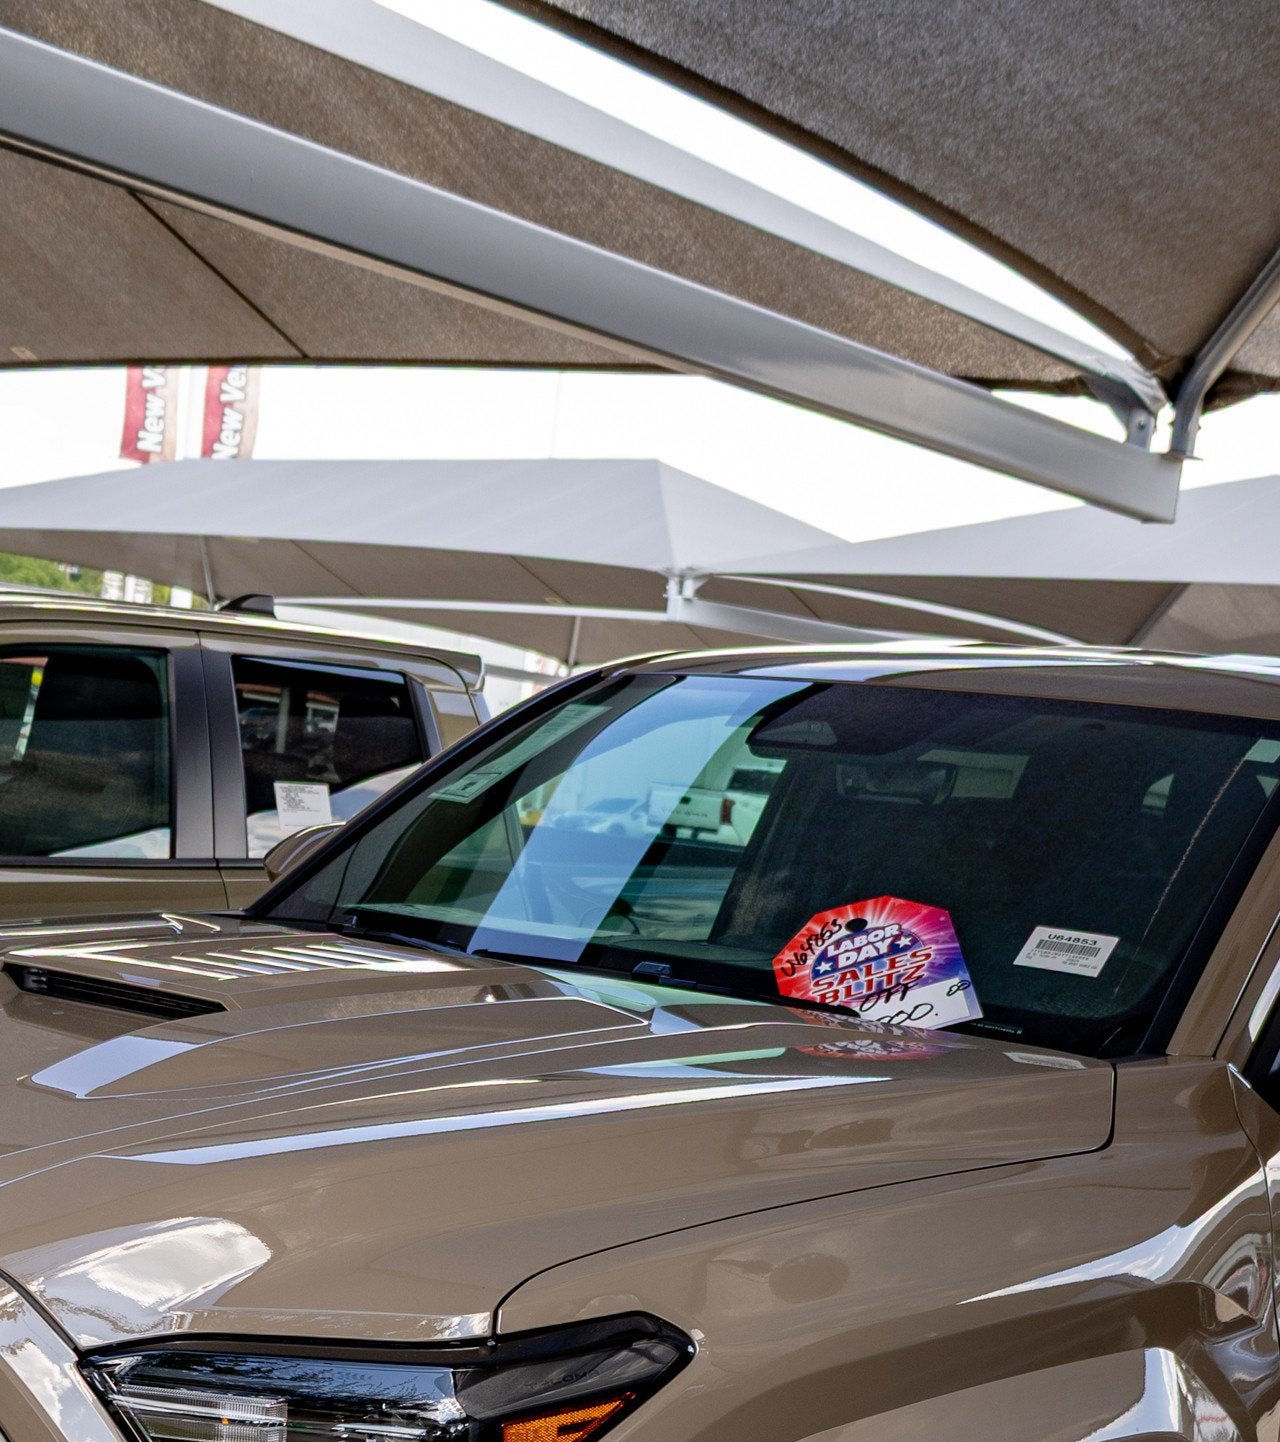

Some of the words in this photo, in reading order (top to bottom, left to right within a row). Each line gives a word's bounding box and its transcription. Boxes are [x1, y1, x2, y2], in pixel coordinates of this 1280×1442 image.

[220, 367, 247, 402] Ve
[136, 393, 165, 453] New
[826, 923, 901, 957] LABOR
[837, 938, 891, 968] DAY
[1048, 933, 1097, 946] U64853
[812, 946, 933, 992] SALES
[817, 964, 925, 1005] BLITZ
